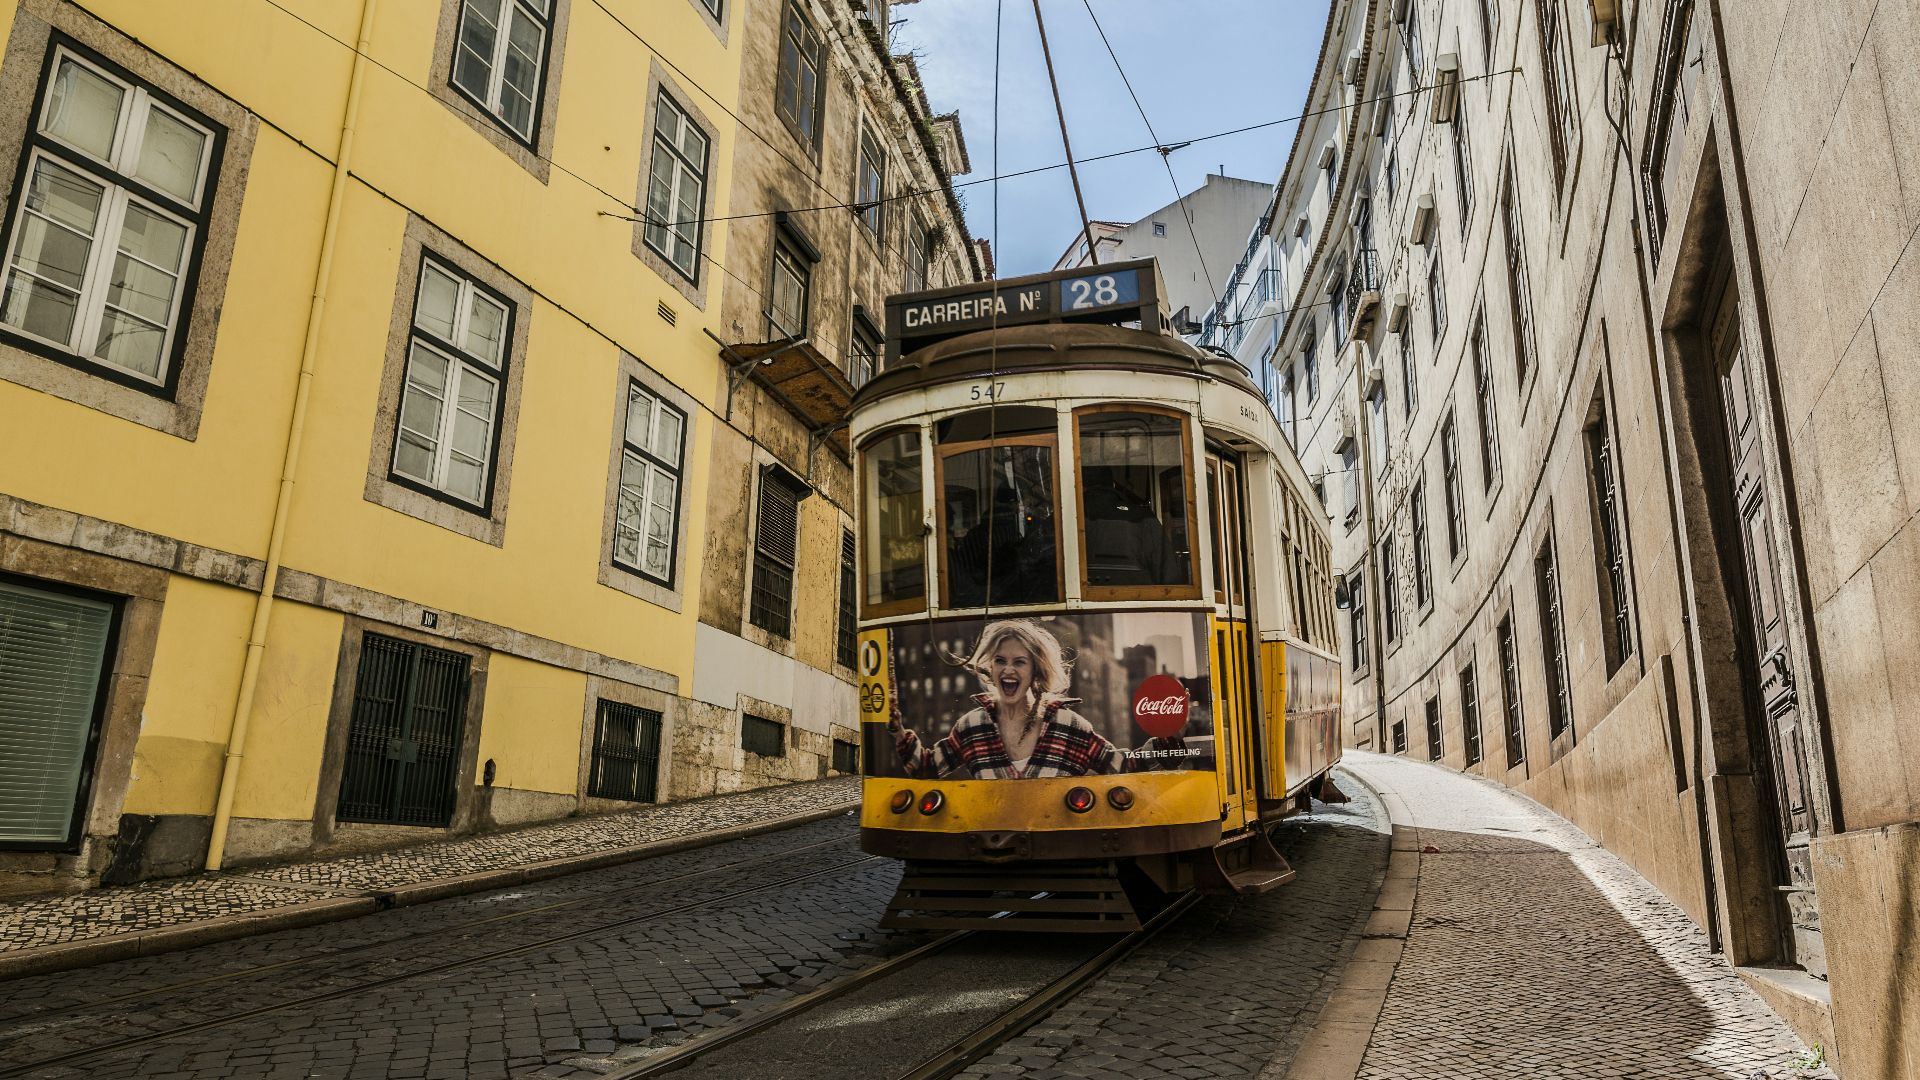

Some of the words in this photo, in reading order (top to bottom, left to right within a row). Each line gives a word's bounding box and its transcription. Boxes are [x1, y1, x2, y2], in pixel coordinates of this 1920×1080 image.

[905, 296, 1007, 327] CARREIRA
[1070, 275, 1119, 309] 28
[971, 382, 1006, 401] 547
[1135, 696, 1186, 716] Coca-Cola
[1124, 750, 1151, 759] TASTE
[1151, 749, 1168, 758] THE
[1169, 748, 1201, 757] FEELING
